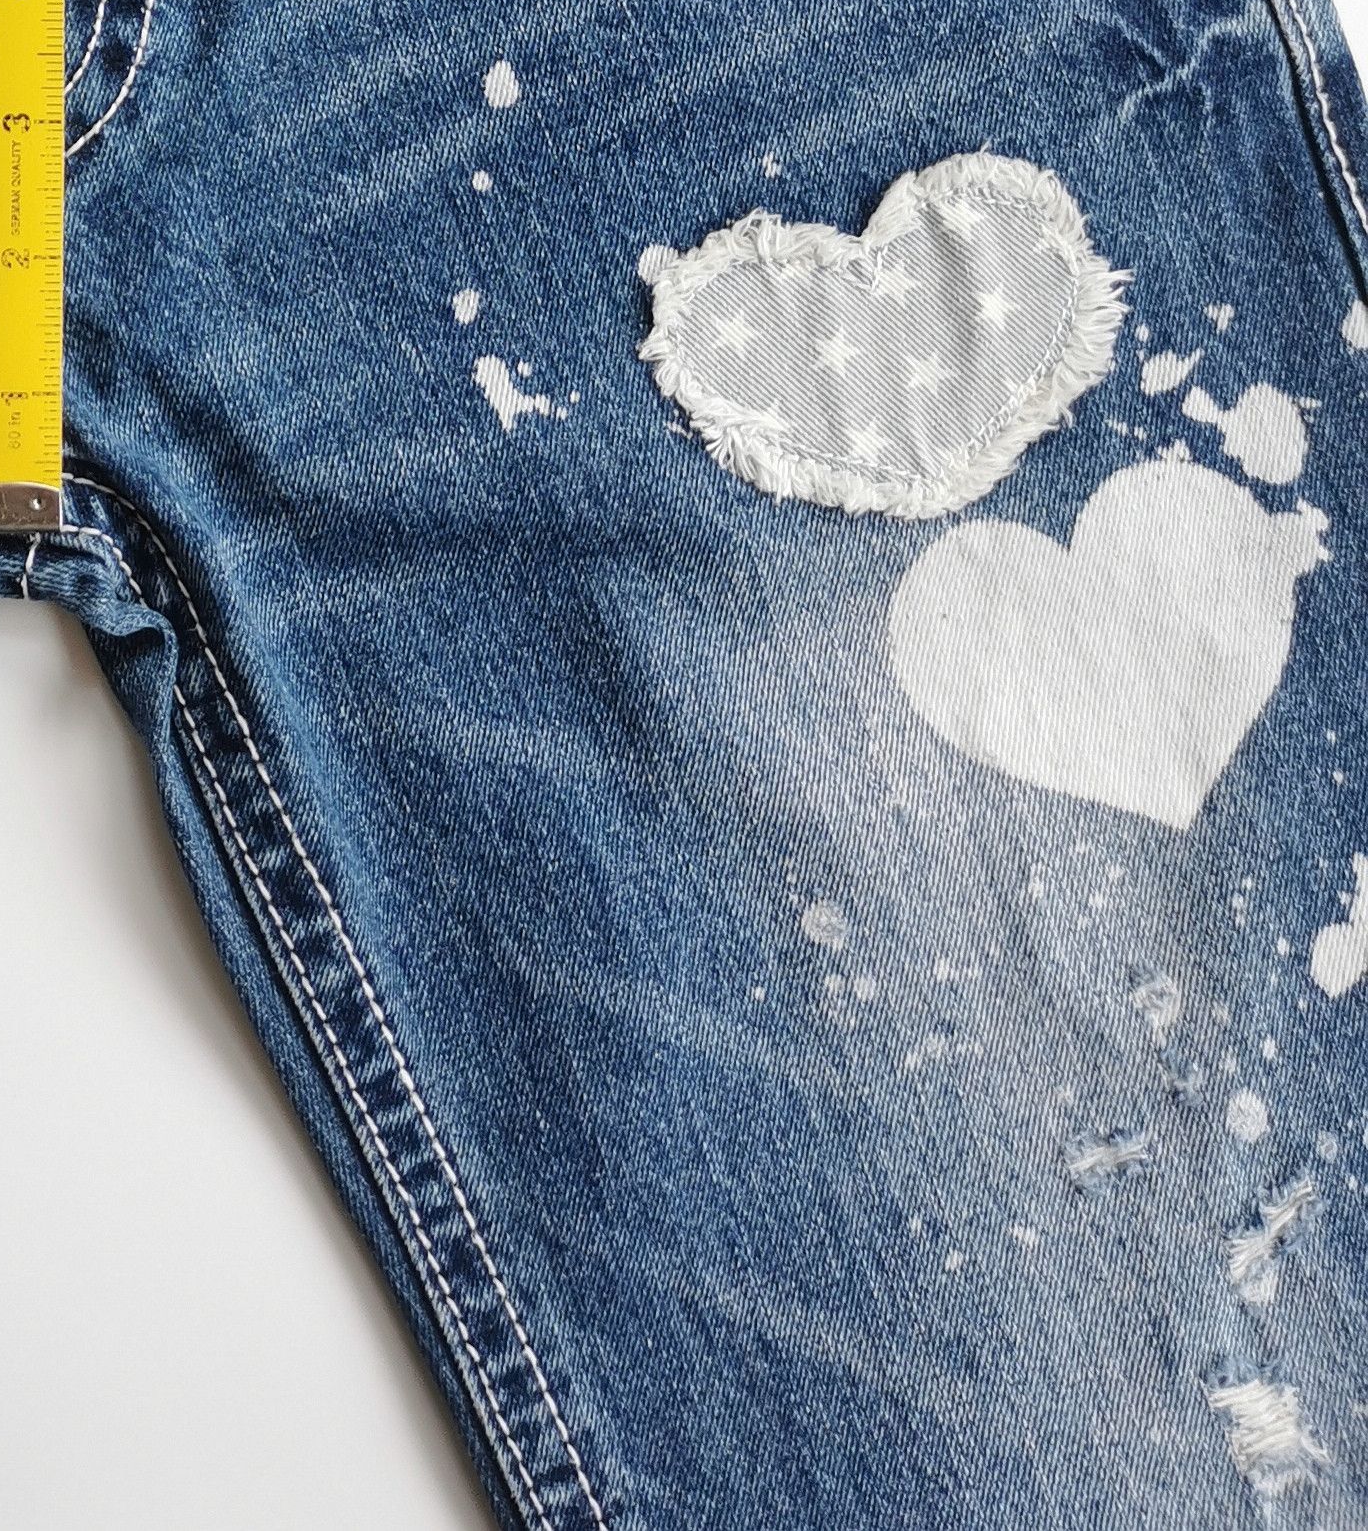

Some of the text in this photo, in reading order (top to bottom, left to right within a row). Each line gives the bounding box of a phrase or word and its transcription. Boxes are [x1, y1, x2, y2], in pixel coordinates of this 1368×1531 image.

[2, 113, 30, 133] 3
[12, 139, 21, 187] QUALITY
[0, 248, 30, 269] 2
